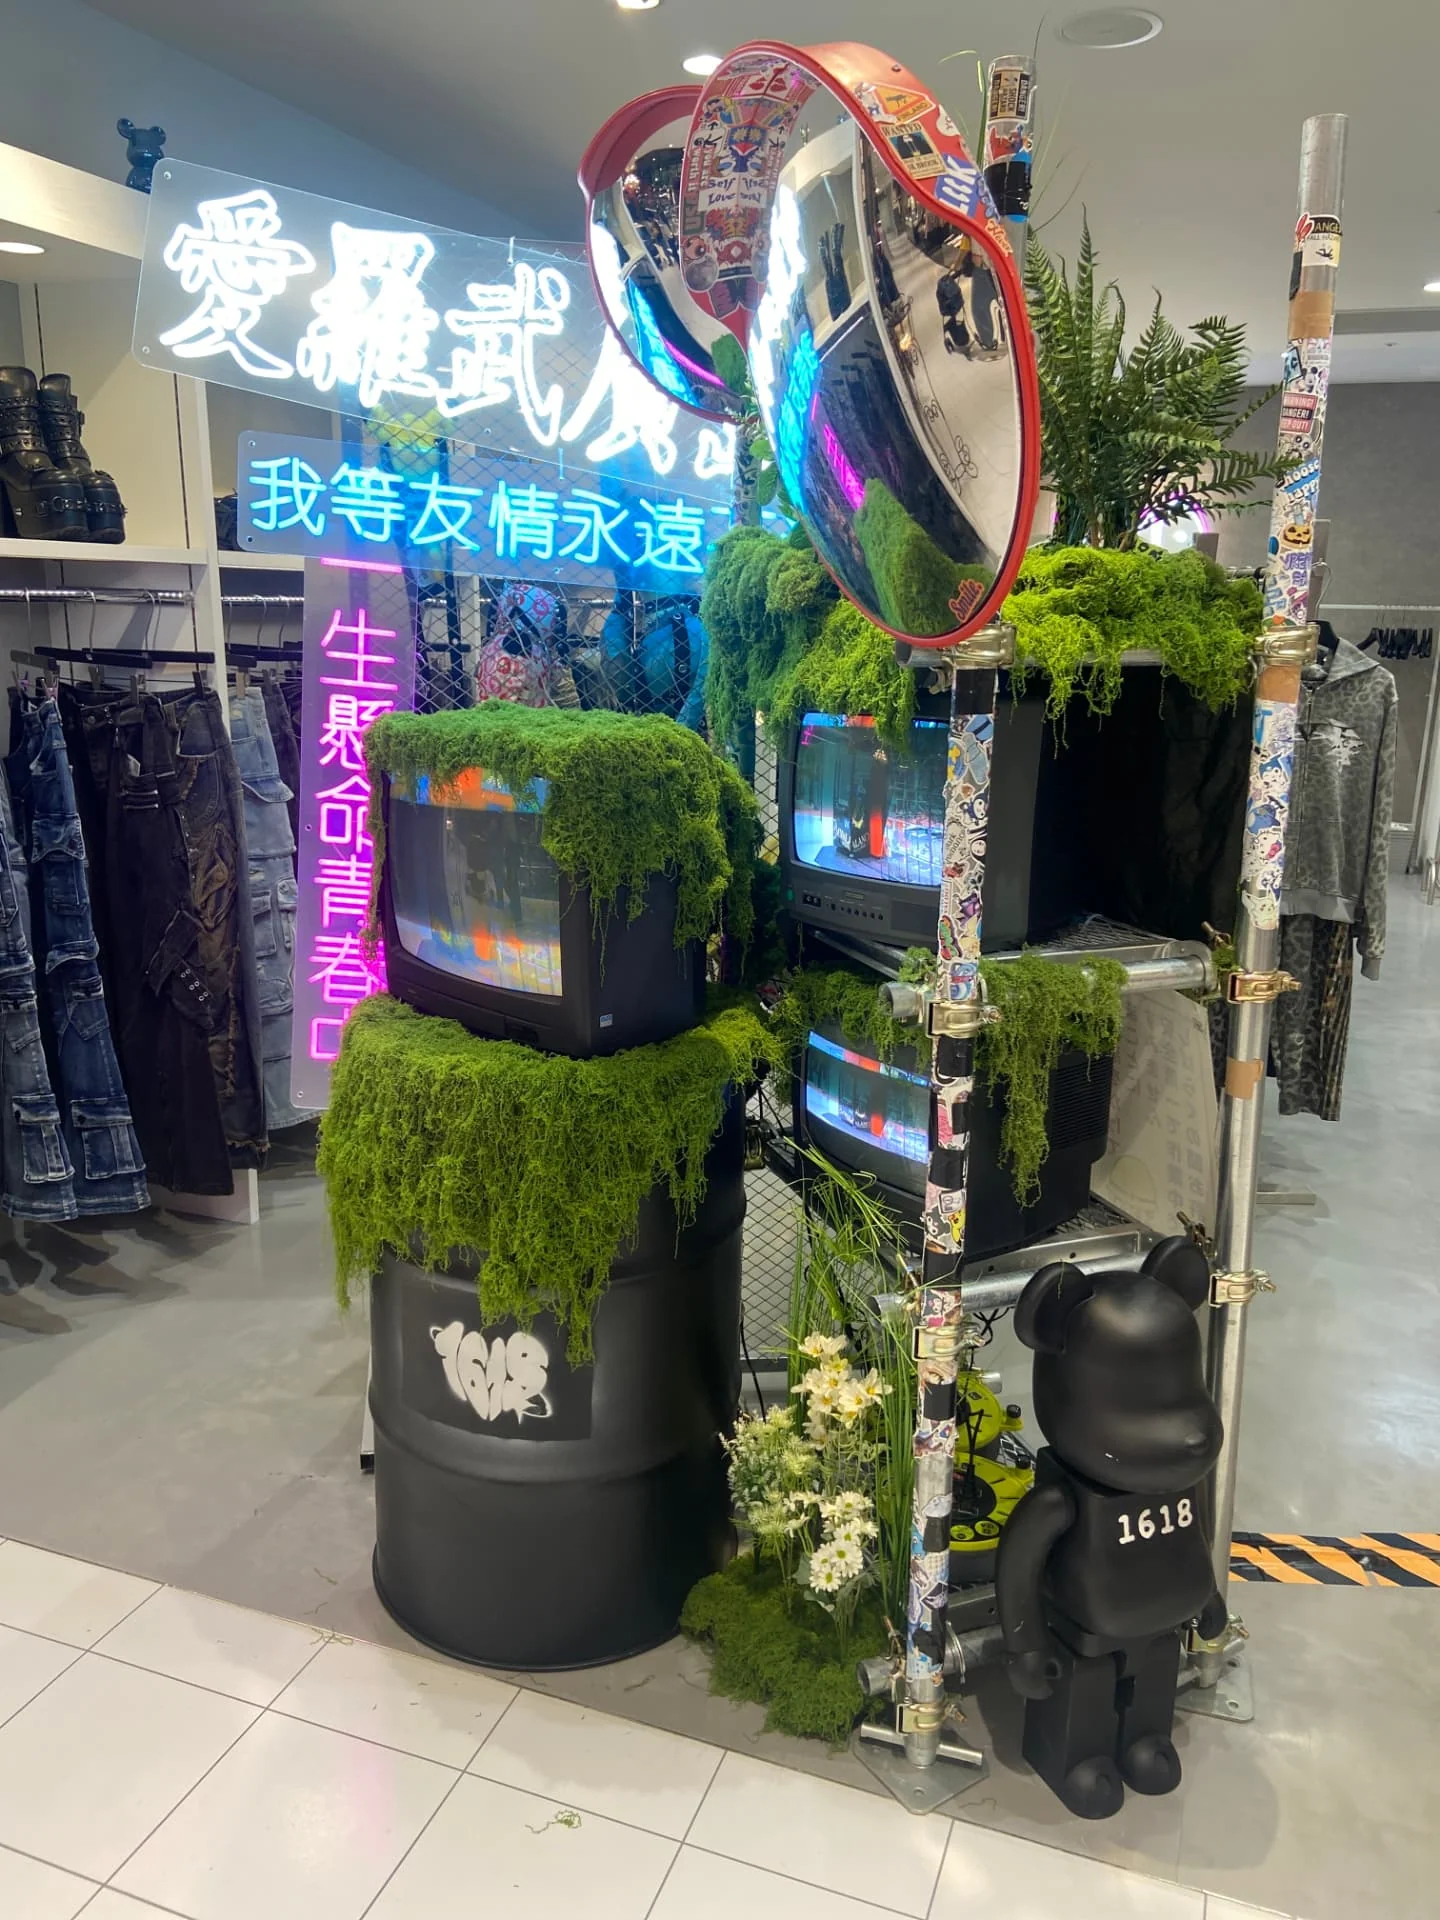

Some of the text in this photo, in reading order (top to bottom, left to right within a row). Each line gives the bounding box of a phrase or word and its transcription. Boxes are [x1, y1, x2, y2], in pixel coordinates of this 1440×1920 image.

[881, 124, 922, 137] WANTED
[248, 455, 734, 574] 我等友情永遠
[1118, 1498, 1193, 1545] 1618
